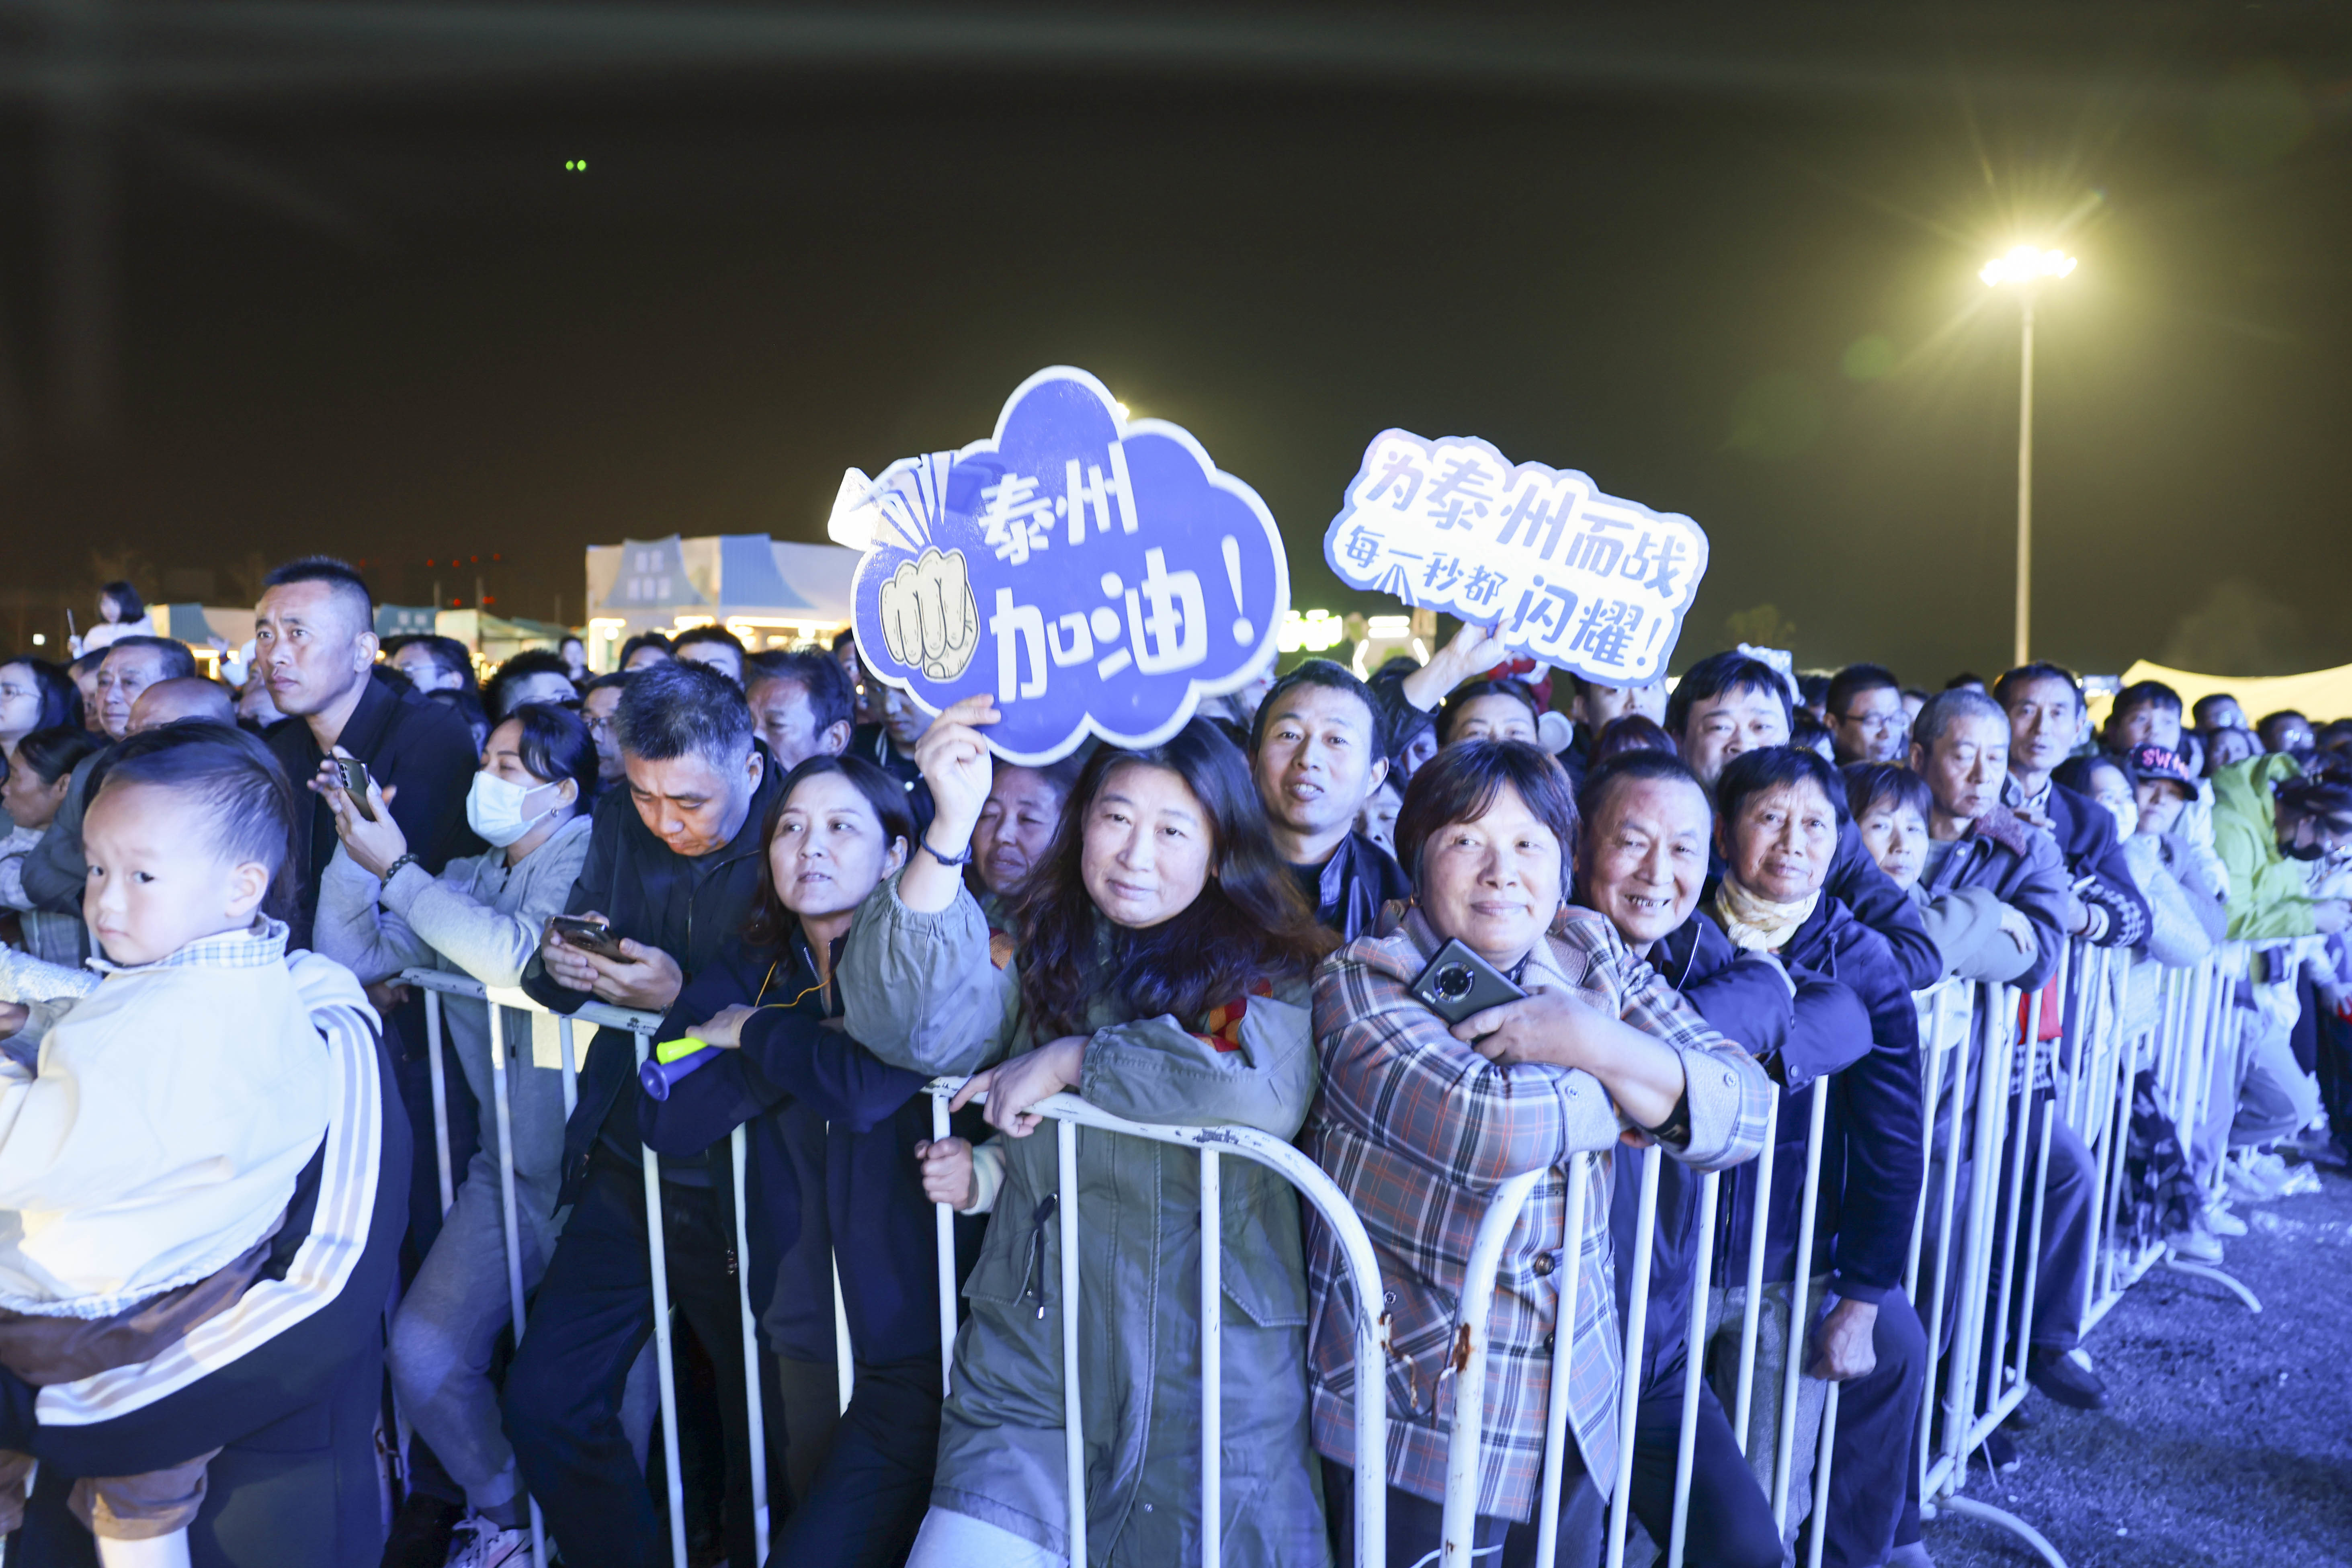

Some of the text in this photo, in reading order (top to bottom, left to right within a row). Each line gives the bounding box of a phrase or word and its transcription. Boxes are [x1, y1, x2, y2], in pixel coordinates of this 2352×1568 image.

[978, 441, 1138, 566] 泰州
[1366, 451, 1686, 598] 为泰州而战
